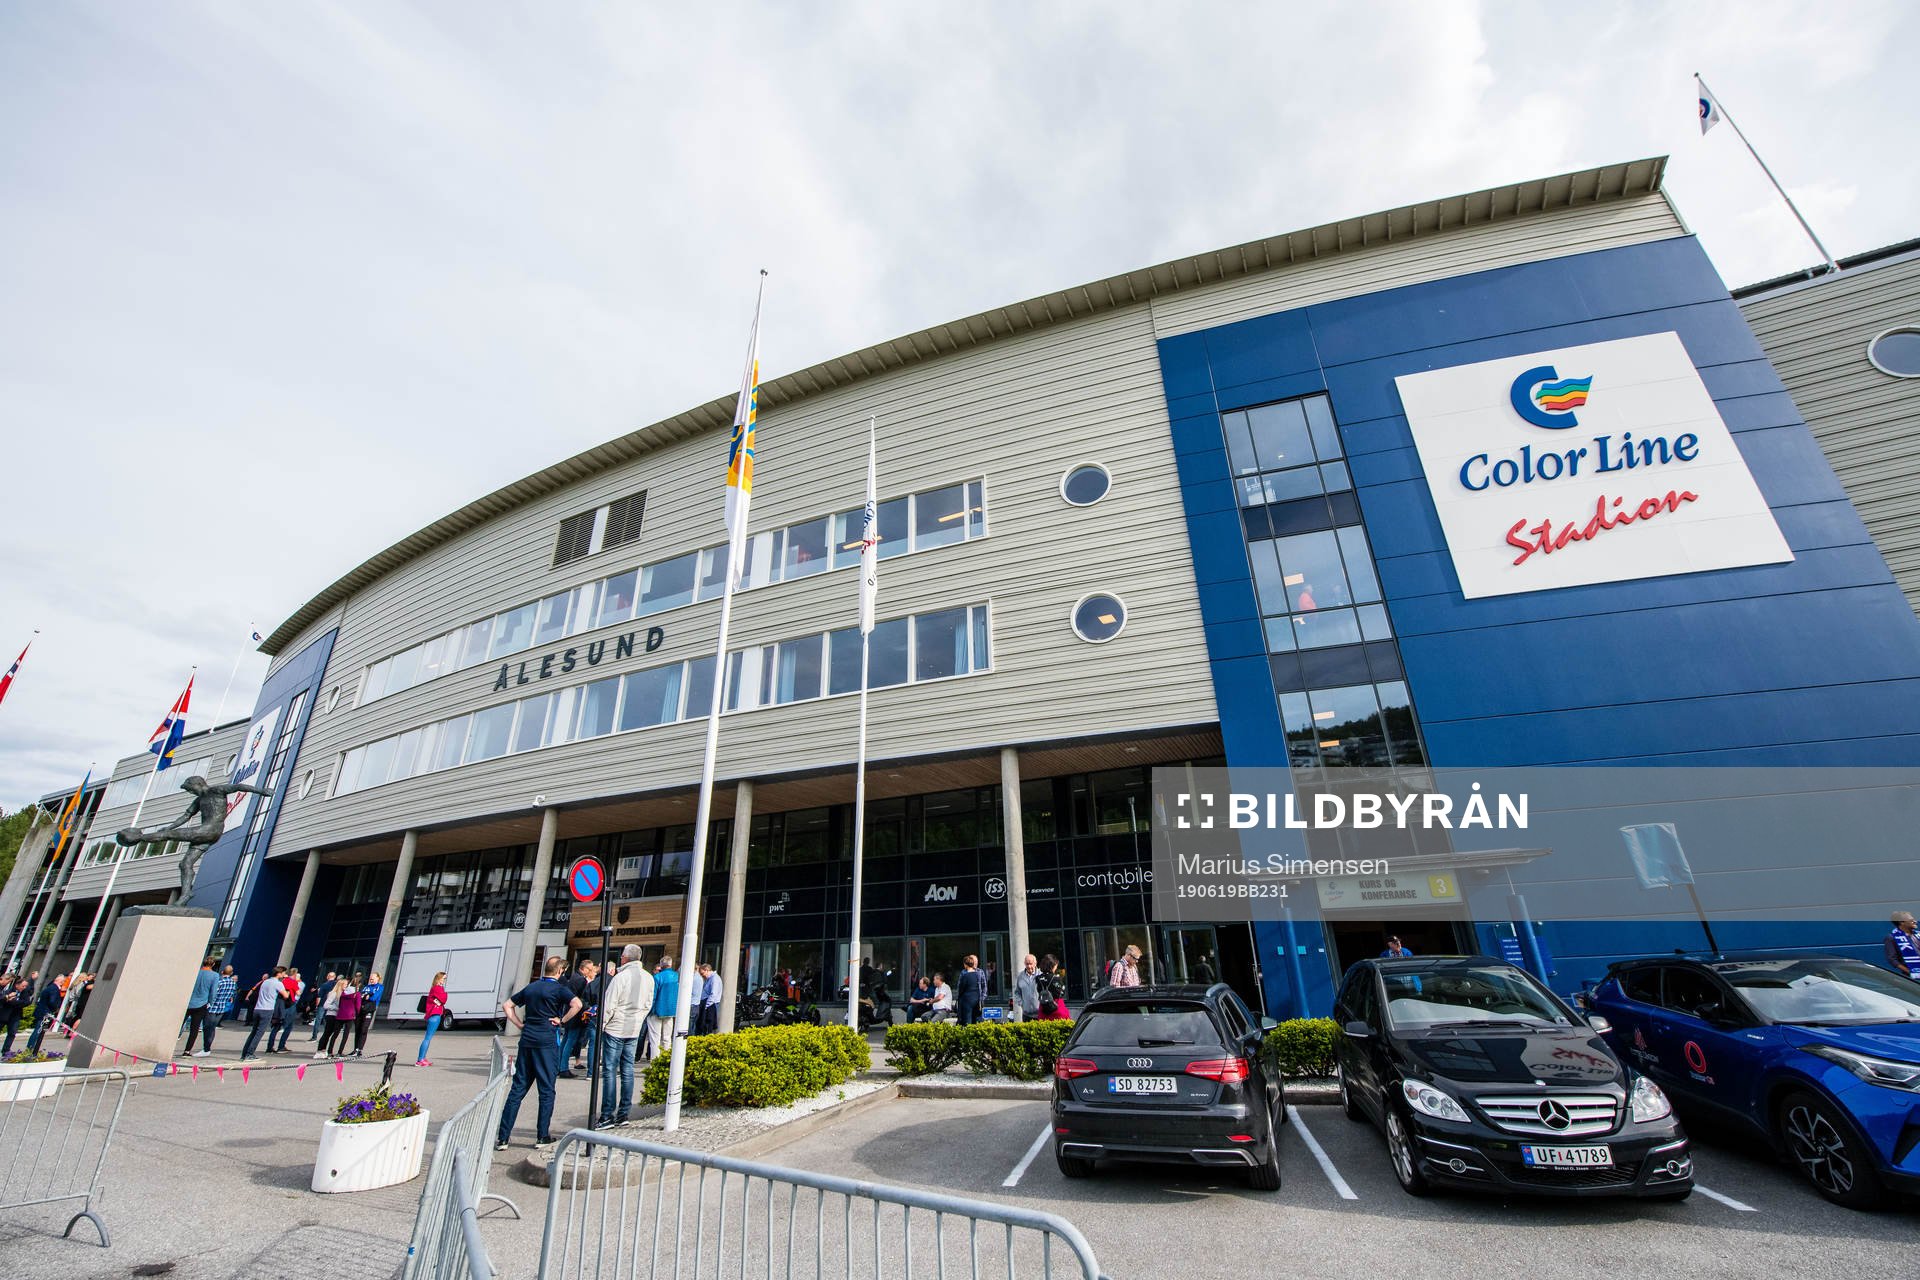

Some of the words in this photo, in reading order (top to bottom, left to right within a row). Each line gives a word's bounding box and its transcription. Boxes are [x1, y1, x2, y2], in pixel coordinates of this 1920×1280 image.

[1460, 445, 1587, 490] Color
[1593, 431, 1699, 473] Line
[1506, 490, 1699, 565] Stadion
[493, 627, 664, 691] ÅLESUND
[1077, 867, 1153, 889] contabile
[1359, 879, 1382, 889] KURS
[1384, 879, 1397, 888] OG
[1436, 878, 1447, 894] 3
[1361, 889, 1418, 901] KONFERANSE
[1118, 1077, 1133, 1091] SD
[1137, 1077, 1174, 1091] 82753
[1536, 1148, 1557, 1163] UF
[1565, 1148, 1608, 1164] 41789
